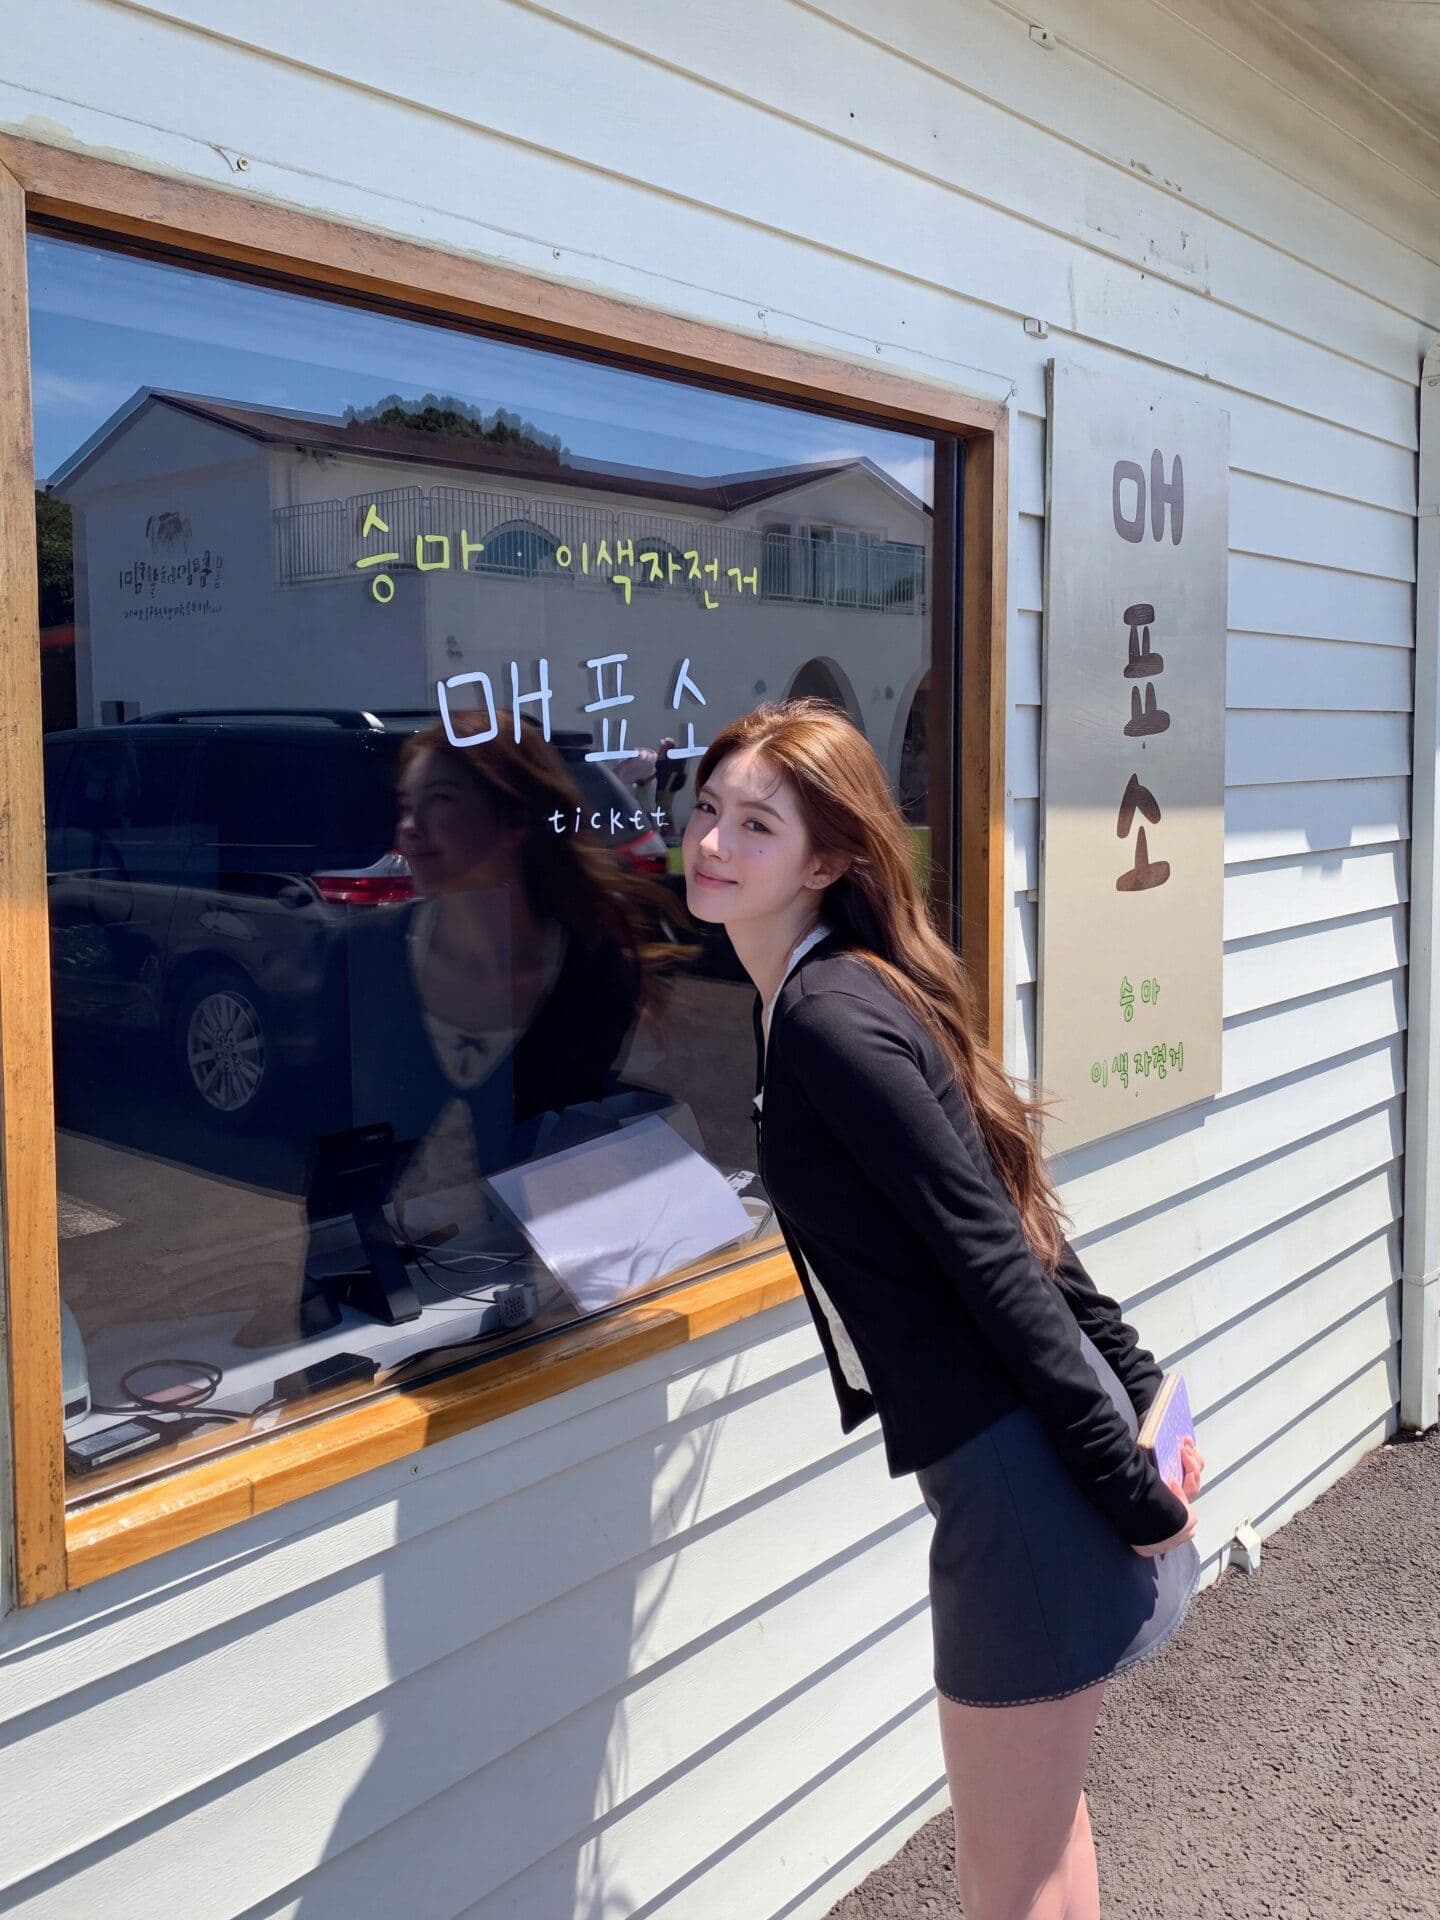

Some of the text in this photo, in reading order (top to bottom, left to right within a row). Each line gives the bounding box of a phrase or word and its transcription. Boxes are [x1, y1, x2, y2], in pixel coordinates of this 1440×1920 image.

[356, 503, 485, 603] 승마
[437, 652, 709, 763] 매표소
[1112, 448, 1185, 892] 매표소
[548, 806, 669, 835] ticket
